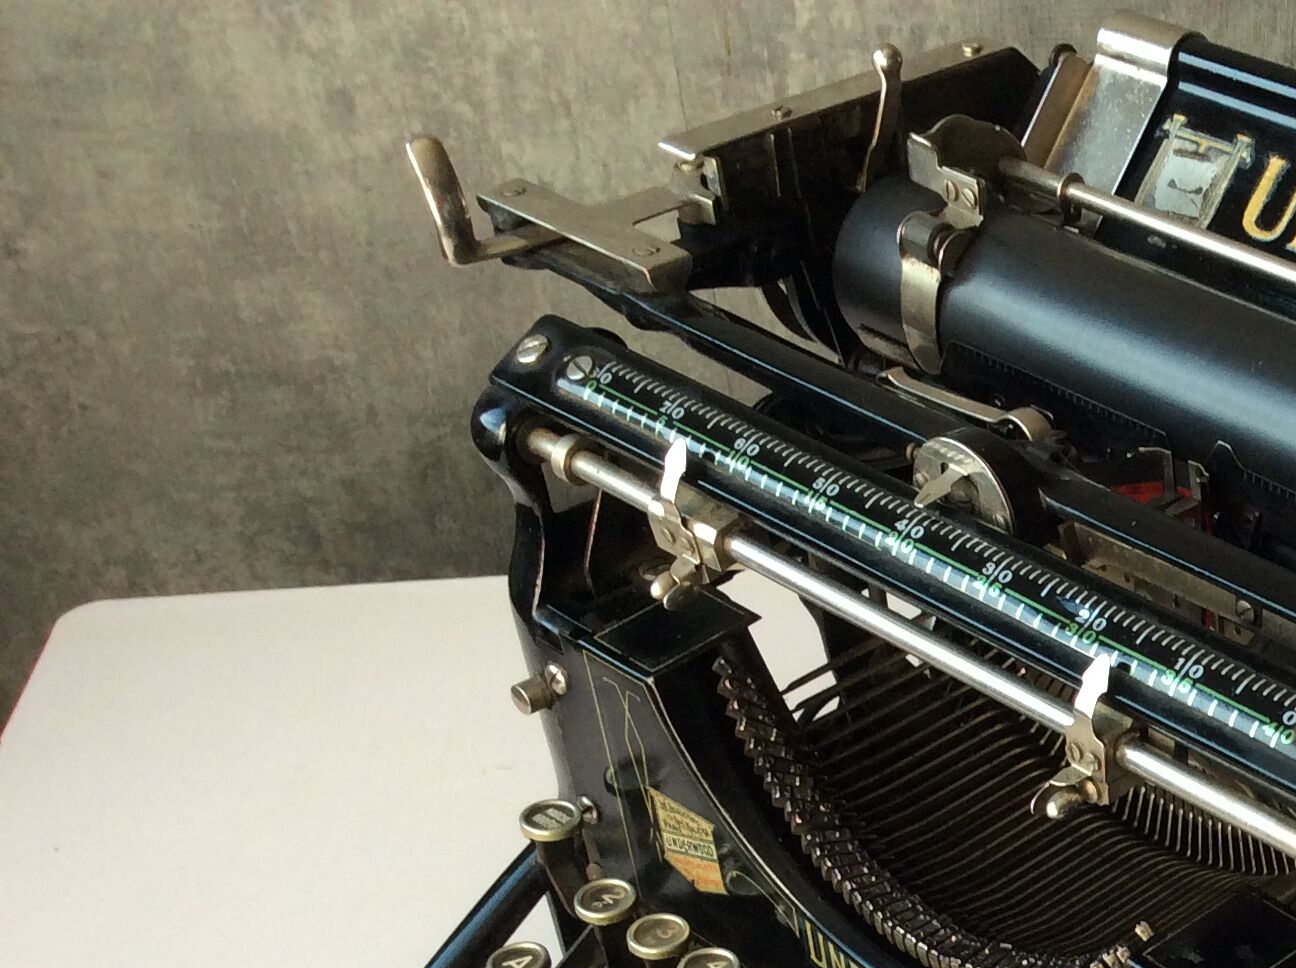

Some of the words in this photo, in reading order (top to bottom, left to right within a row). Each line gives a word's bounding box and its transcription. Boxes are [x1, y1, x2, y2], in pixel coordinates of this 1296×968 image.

[659, 400, 685, 419] 70
[734, 438, 760, 456] 60
[812, 477, 840, 496] 50
[894, 518, 925, 538] 40
[982, 562, 1012, 583] 30
[1075, 609, 1107, 631] 20
[1174, 657, 1204, 679] 10
[886, 530, 915, 553] 20
[974, 575, 1002, 597] 25
[1065, 621, 1097, 644] 30
[1161, 669, 1193, 693] 35
[1261, 723, 1296, 745] 40
[601, 887, 626, 904] 2
